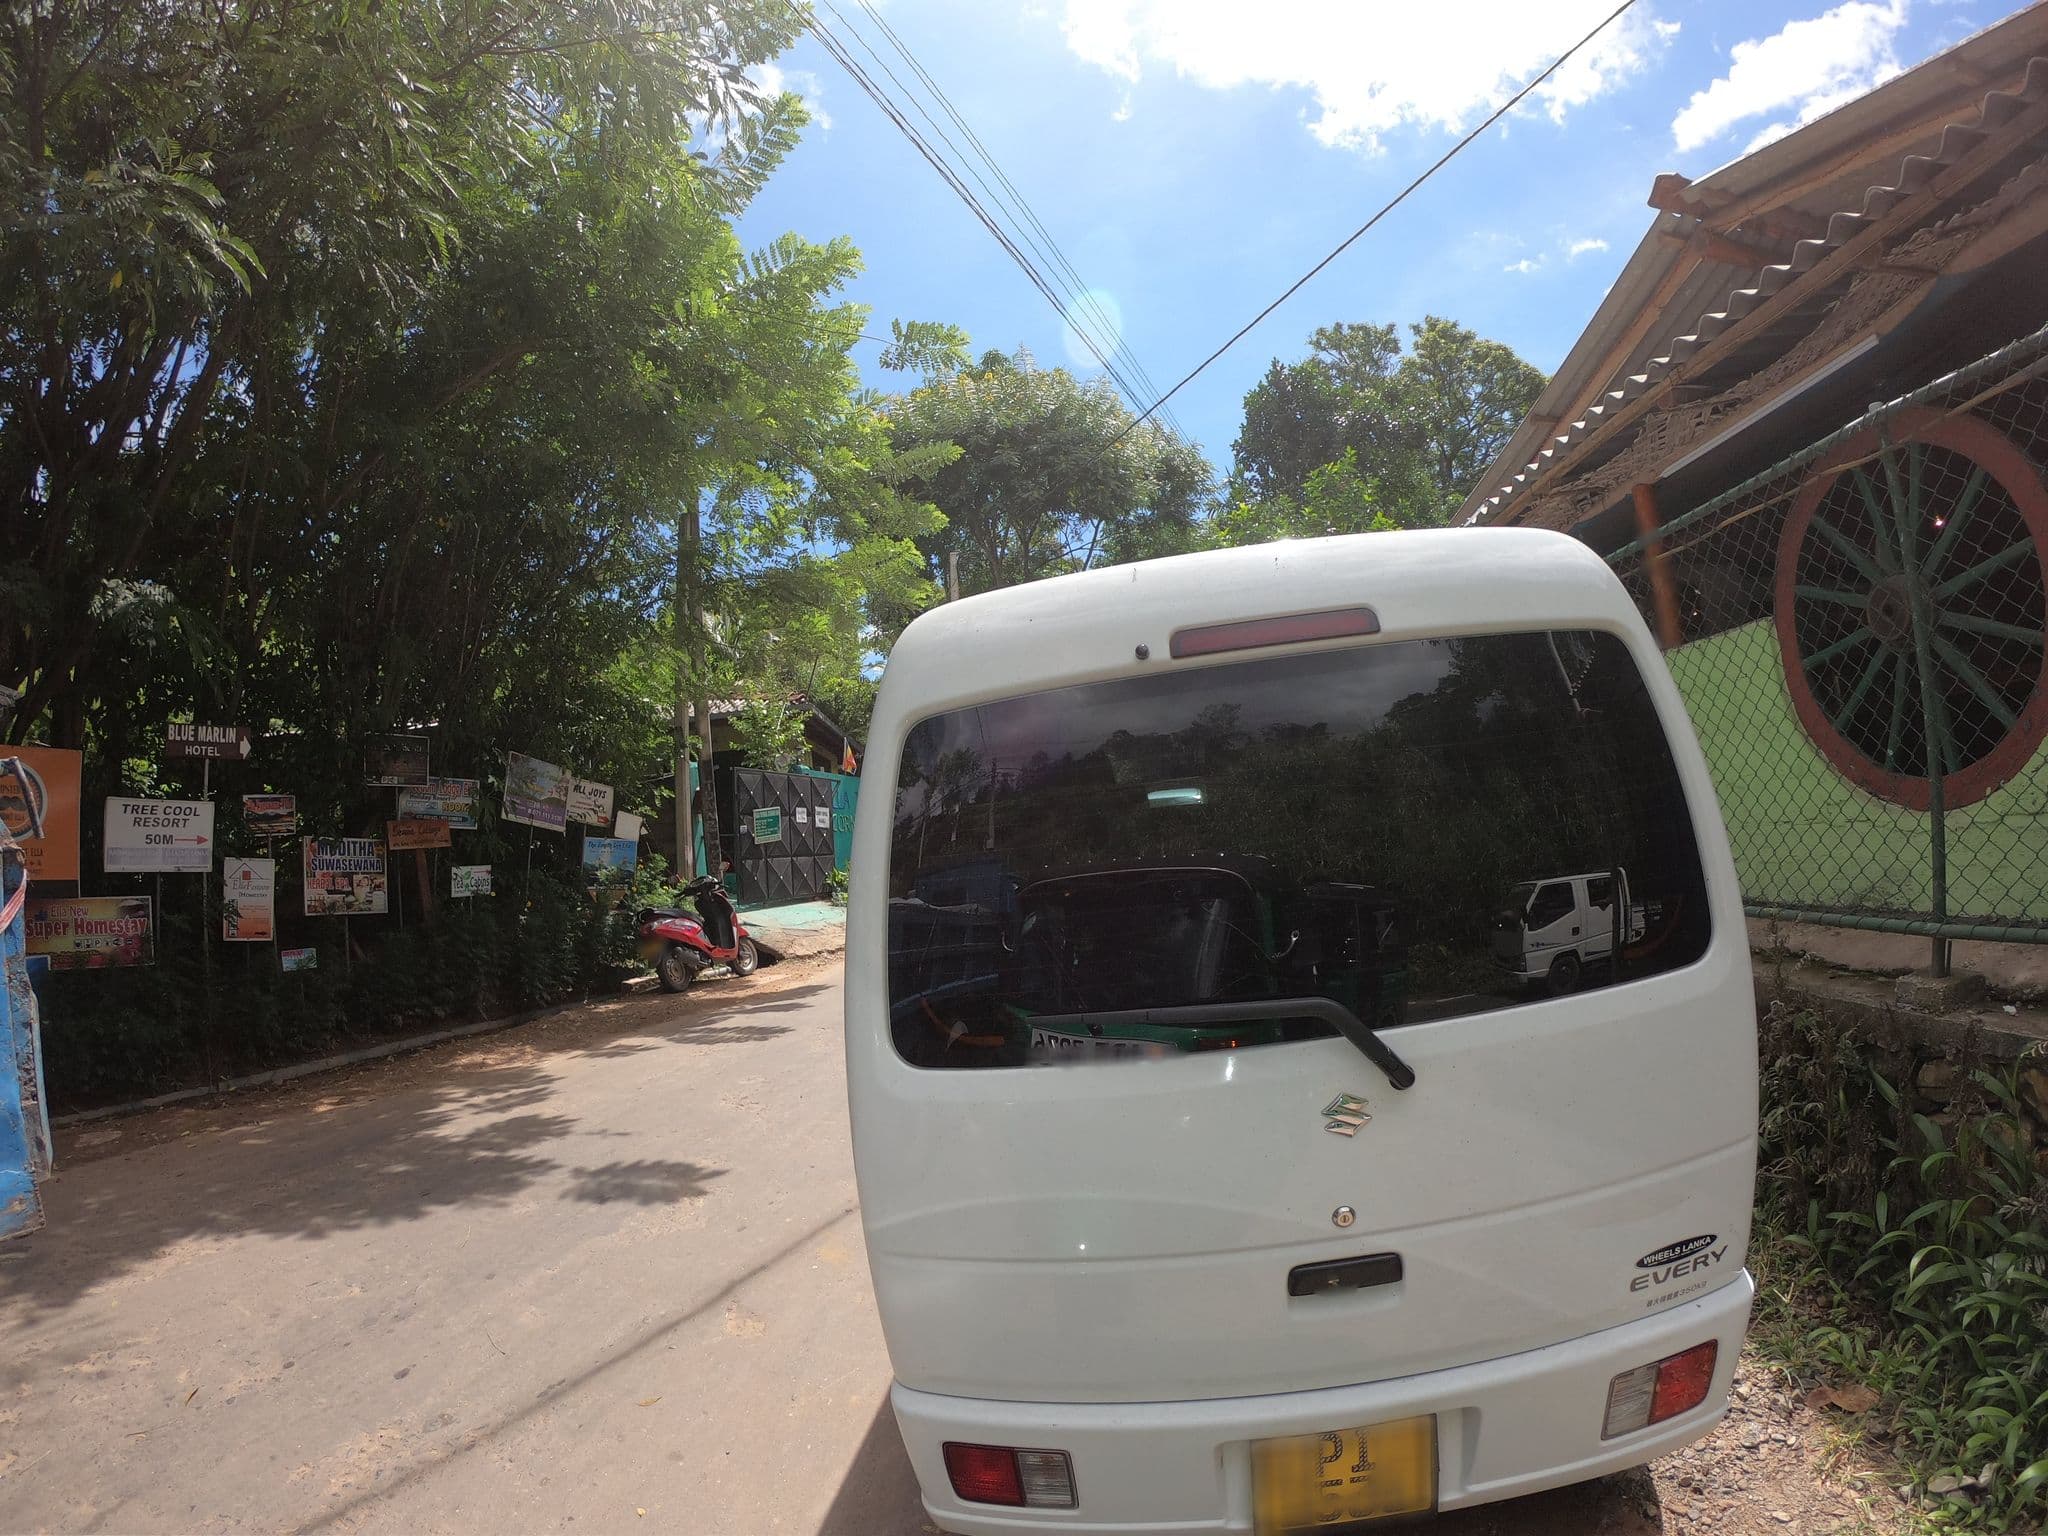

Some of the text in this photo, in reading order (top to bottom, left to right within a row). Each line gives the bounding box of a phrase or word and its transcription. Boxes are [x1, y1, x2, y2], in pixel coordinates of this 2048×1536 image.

[168, 724, 236, 743] BLUE MARLIN
[185, 745, 220, 757] HOTEL
[573, 784, 607, 799] ALL JOYS
[122, 804, 200, 817] TREE COOL
[133, 816, 190, 828] RESORT
[145, 833, 174, 845] 50M
[311, 858, 383, 872] SUWASEWANA
[51, 904, 88, 917] Ella New
[26, 915, 148, 941] Super Homestay
[1644, 1236, 1711, 1265] WHEELS LANKA
[1630, 1245, 1728, 1292] EVERY
